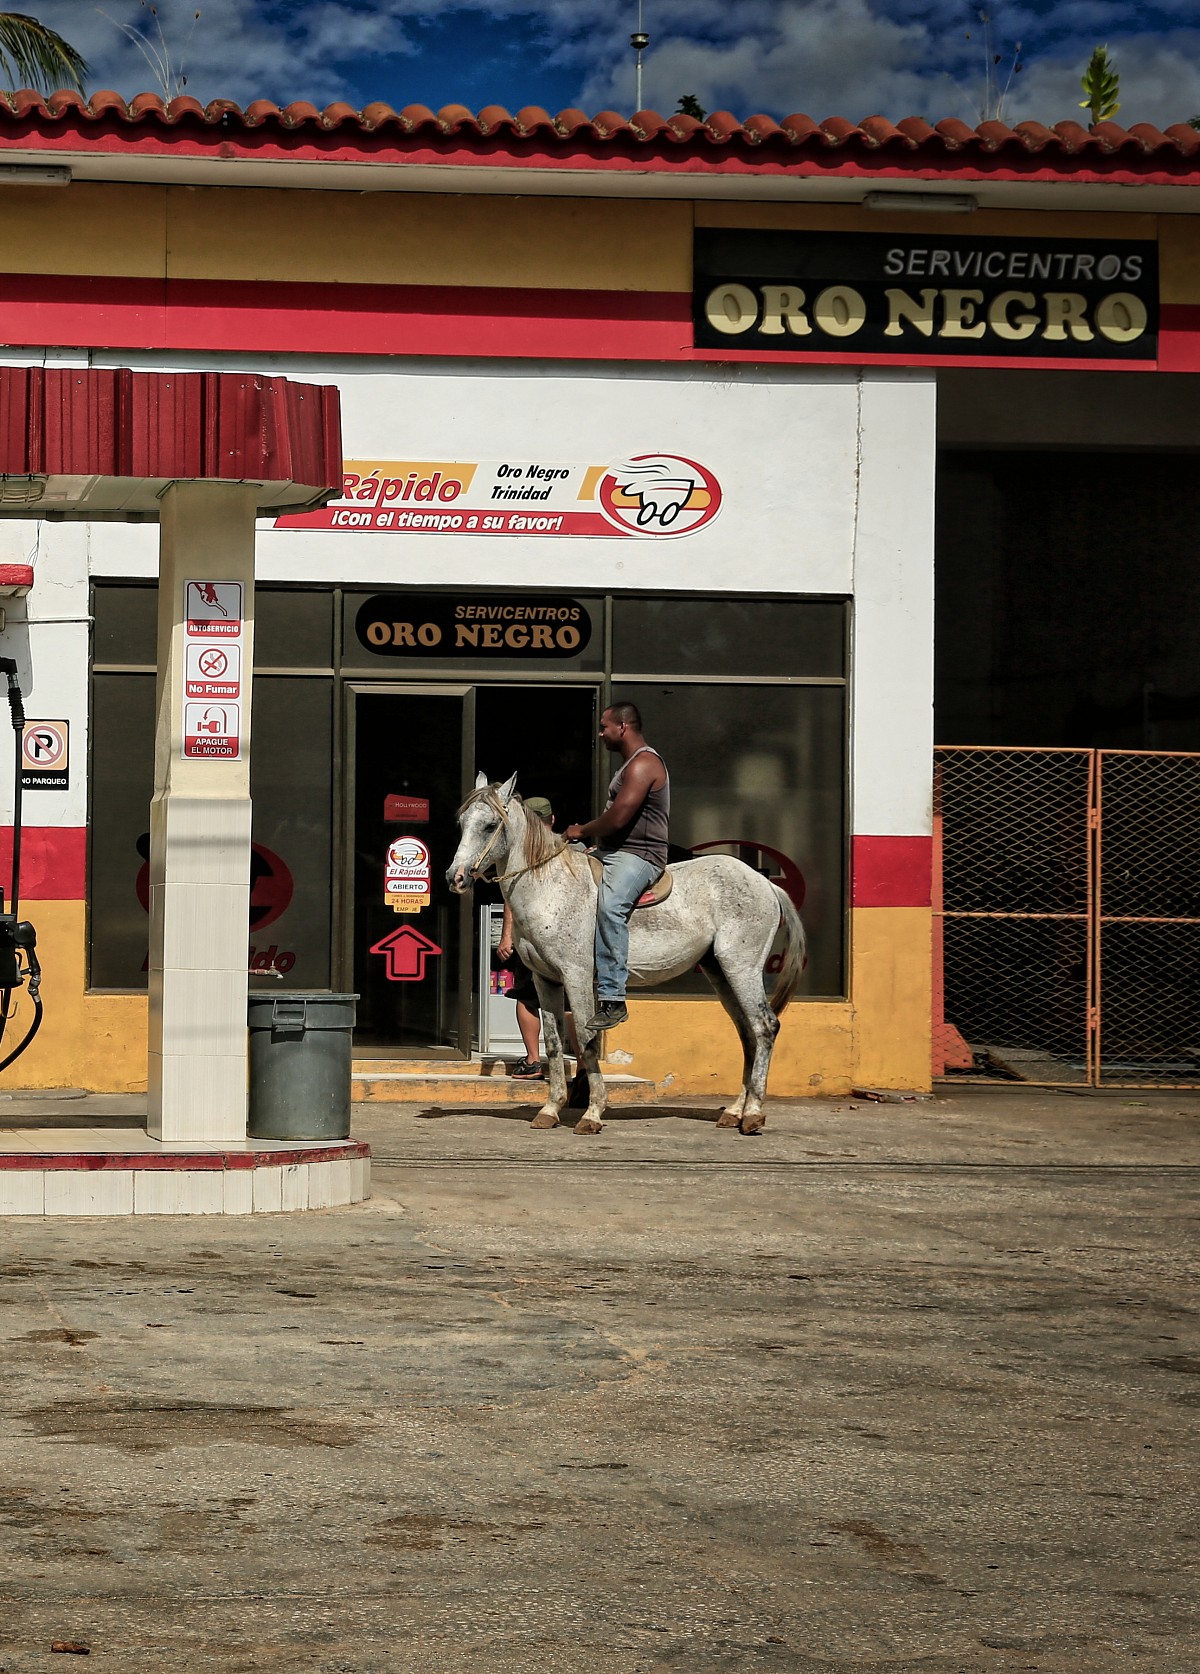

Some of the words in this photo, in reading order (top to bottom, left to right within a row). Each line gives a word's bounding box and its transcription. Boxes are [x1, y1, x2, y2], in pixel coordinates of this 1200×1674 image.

[883, 248, 1143, 281] SERVICENTROS
[705, 283, 867, 338] ORO
[883, 289, 1148, 342] NEGRO
[497, 464, 522, 478] Oro
[526, 465, 570, 481] Negro
[343, 470, 462, 507] Rápido
[491, 485, 553, 500] Trinidad
[331, 510, 372, 527] ¡Con
[376, 512, 394, 527] el
[398, 512, 463, 530] tiempo
[466, 516, 478, 529] a
[482, 516, 505, 529] su
[508, 514, 563, 531] favor!
[455, 606, 580, 620] SERVICENTROS
[189, 625, 239, 633] AUTOSERVICIO
[367, 622, 442, 646] ORO
[455, 624, 580, 649] NEGRO
[189, 685, 203, 693] No
[206, 686, 237, 694] Fumar
[196, 738, 229, 746] APAGUE
[203, 747, 233, 755] MOTOR
